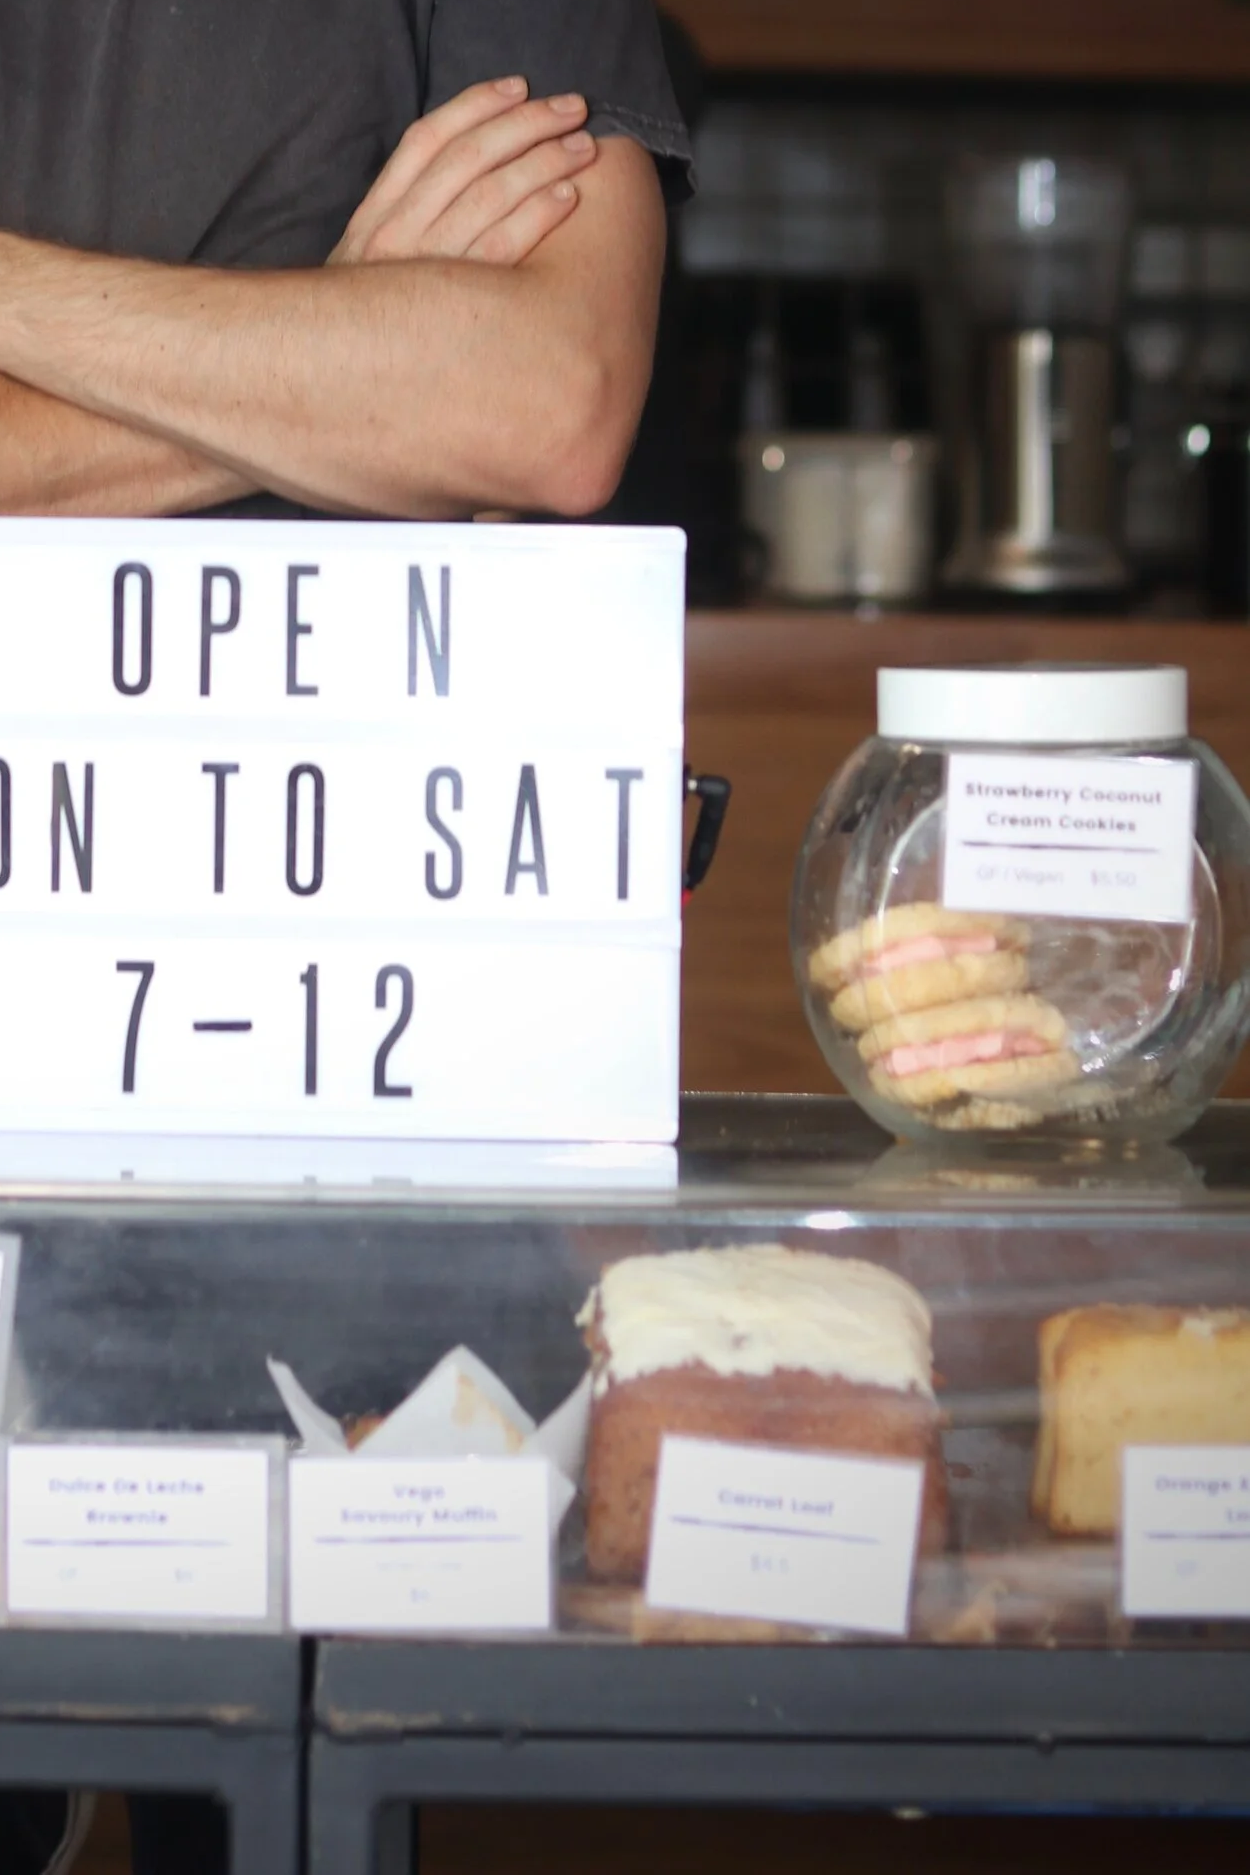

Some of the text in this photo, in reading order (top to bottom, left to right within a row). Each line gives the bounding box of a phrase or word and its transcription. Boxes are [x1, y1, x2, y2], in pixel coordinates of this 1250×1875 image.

[964, 782, 1163, 806] Strawberry Coconut
[201, 762, 326, 897] TO
[423, 766, 645, 901] SAT
[986, 812, 1137, 833] Cream Cookies
